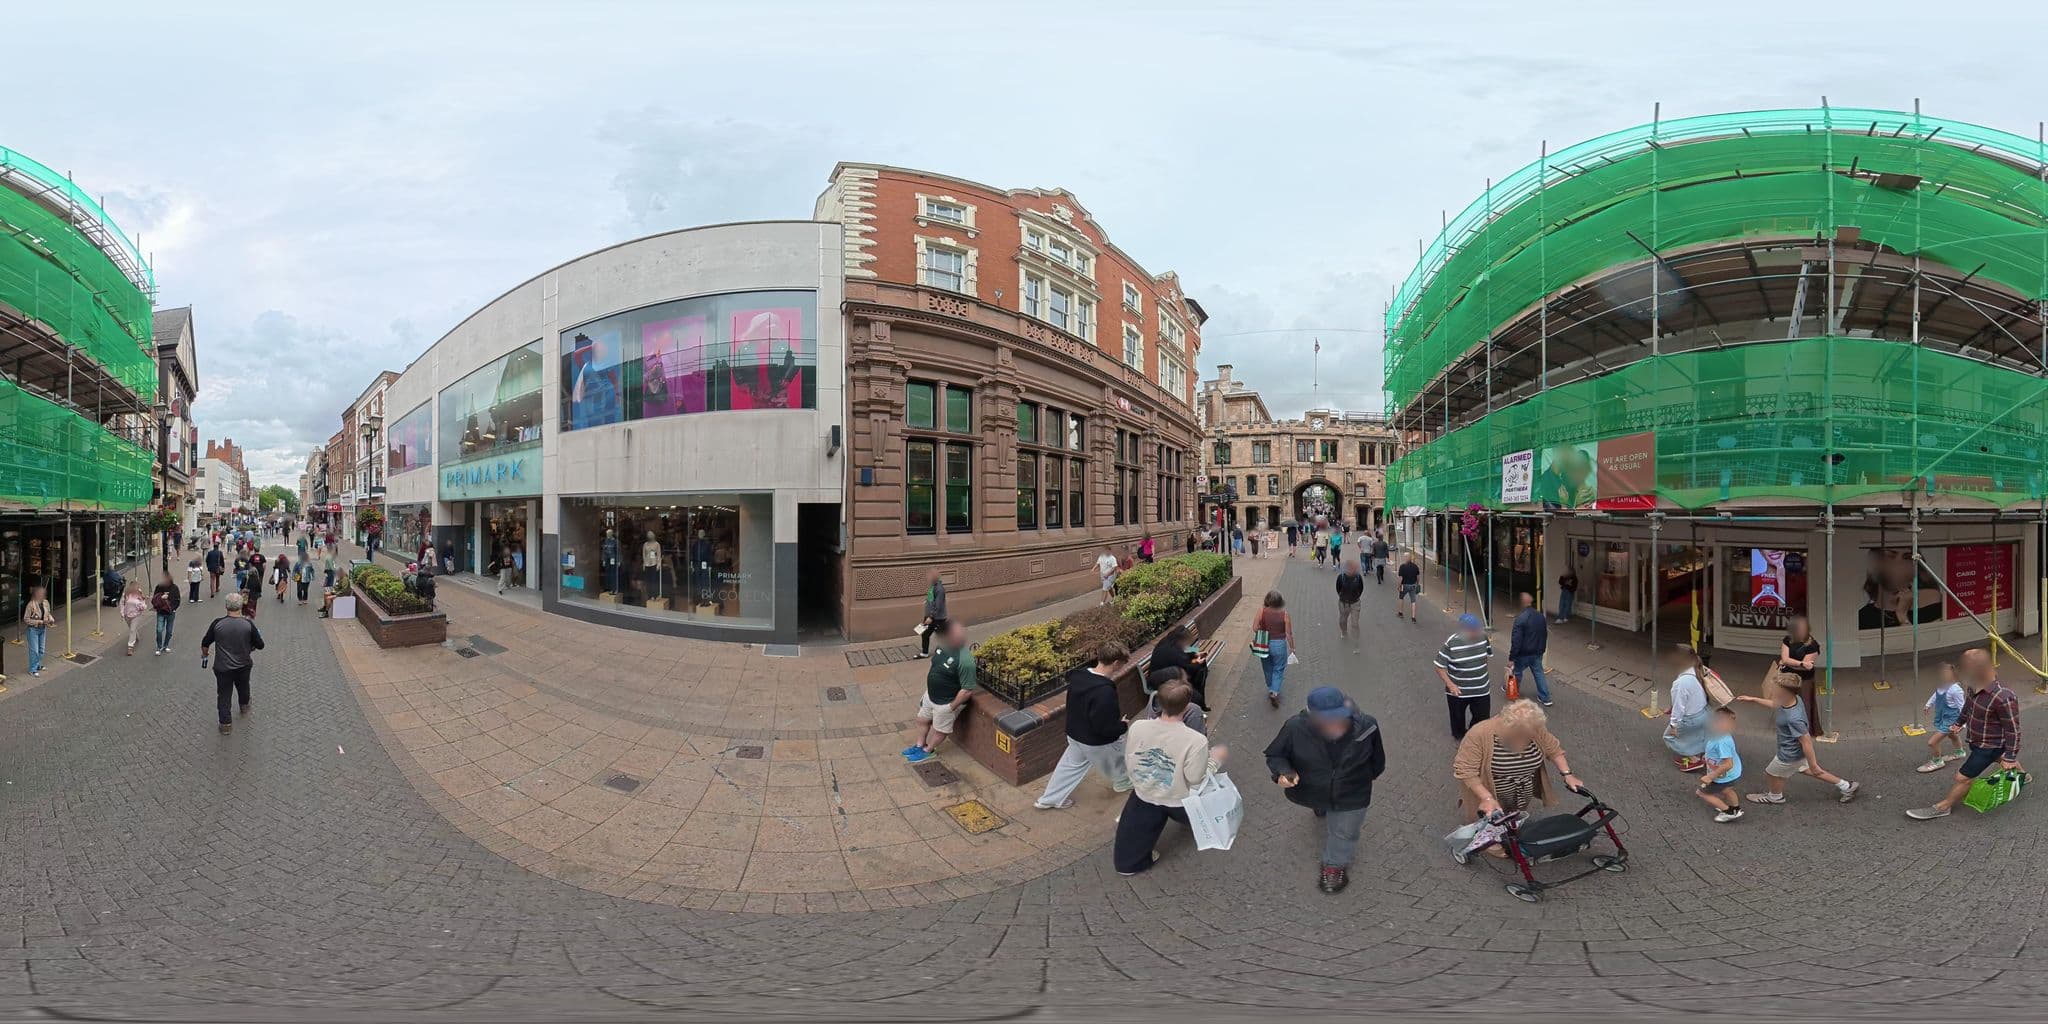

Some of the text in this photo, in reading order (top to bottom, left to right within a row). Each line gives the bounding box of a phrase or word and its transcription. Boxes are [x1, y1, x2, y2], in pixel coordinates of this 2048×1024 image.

[1503, 452, 1532, 465] ALARMED
[1603, 456, 1613, 464] WE
[1629, 452, 1648, 461] OPEN
[1619, 462, 1641, 471] USUAL
[444, 459, 524, 488] PRIMARK
[1956, 570, 1976, 578] CASIO
[1728, 604, 1794, 615] DISCOVER
[1729, 614, 1793, 628] NEW IN
